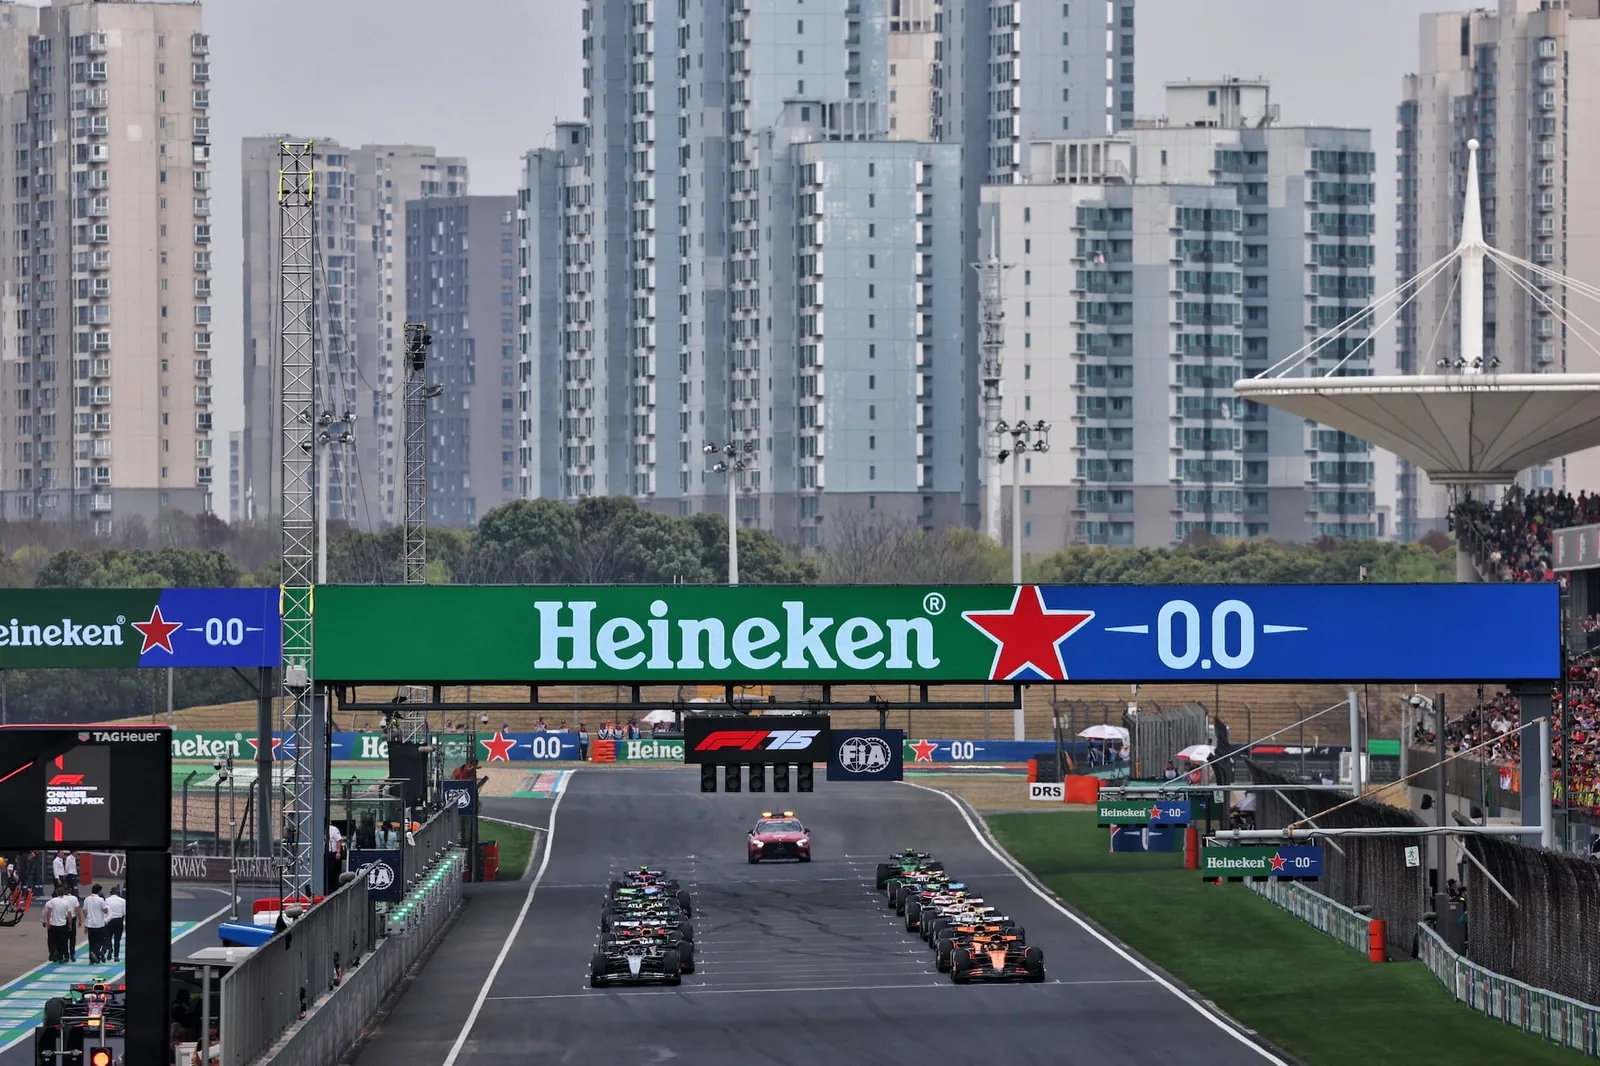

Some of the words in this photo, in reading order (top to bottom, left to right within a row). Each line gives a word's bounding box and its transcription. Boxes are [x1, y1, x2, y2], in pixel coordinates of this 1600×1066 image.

[205, 617, 244, 646] 0.0
[1157, 599, 1255, 670] 0.0
[532, 736, 561, 759] 0.0
[627, 741, 685, 760] Heine
[46, 797, 81, 805] GRAND
[82, 797, 104, 805] PRIX
[1032, 786, 1061, 797] DRS
